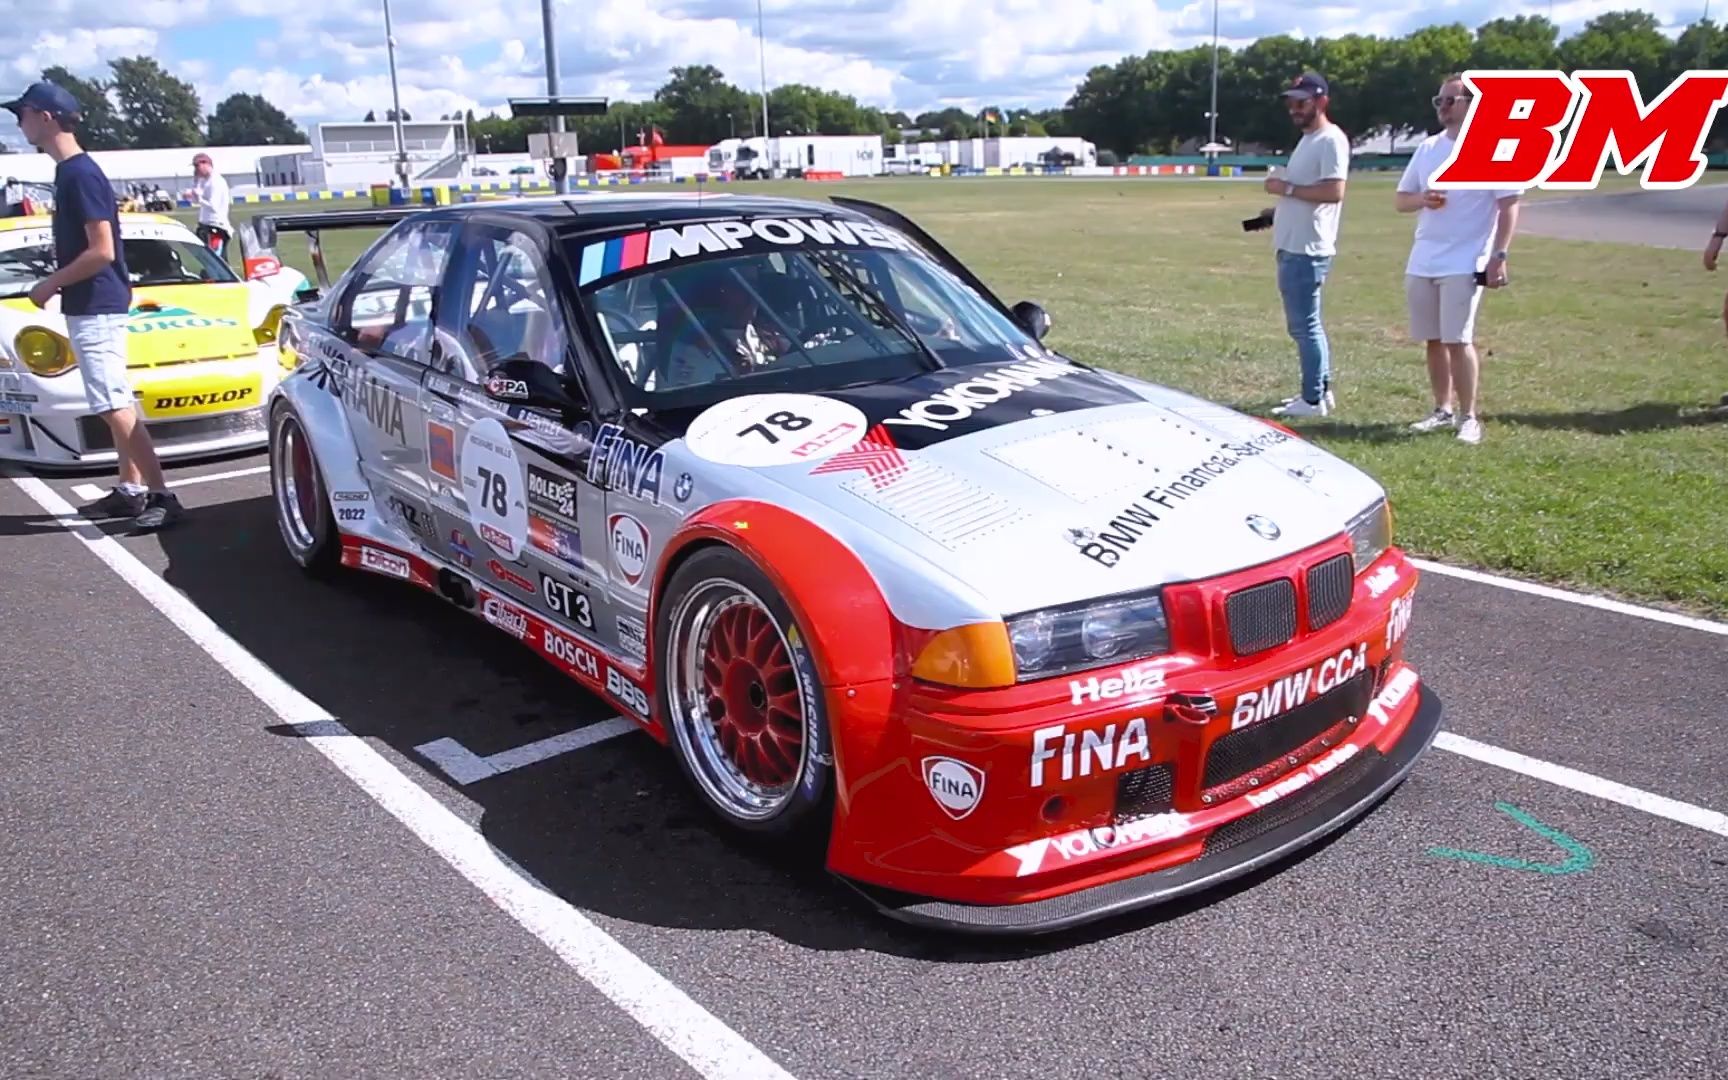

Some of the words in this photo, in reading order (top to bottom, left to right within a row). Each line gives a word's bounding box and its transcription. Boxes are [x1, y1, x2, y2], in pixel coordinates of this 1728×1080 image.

[126, 318, 237, 333] UKOS
[154, 387, 252, 409] DUNLOP
[736, 410, 813, 445] 78
[586, 422, 665, 507] FINA
[477, 465, 508, 518] 78
[528, 472, 561, 501] ROLEX
[338, 508, 366, 521] 2022
[558, 496, 575, 518] 24
[614, 529, 644, 563] FINA
[1079, 501, 1160, 568] BMW
[544, 630, 600, 679] BOSCH
[606, 664, 650, 717] BBS
[1068, 667, 1168, 706] Hella
[1231, 667, 1313, 730] BMW
[1315, 642, 1368, 695] CCA
[801, 671, 819, 790] MICHELIN
[1030, 716, 1150, 788] FINA
[931, 770, 975, 800] FINA
